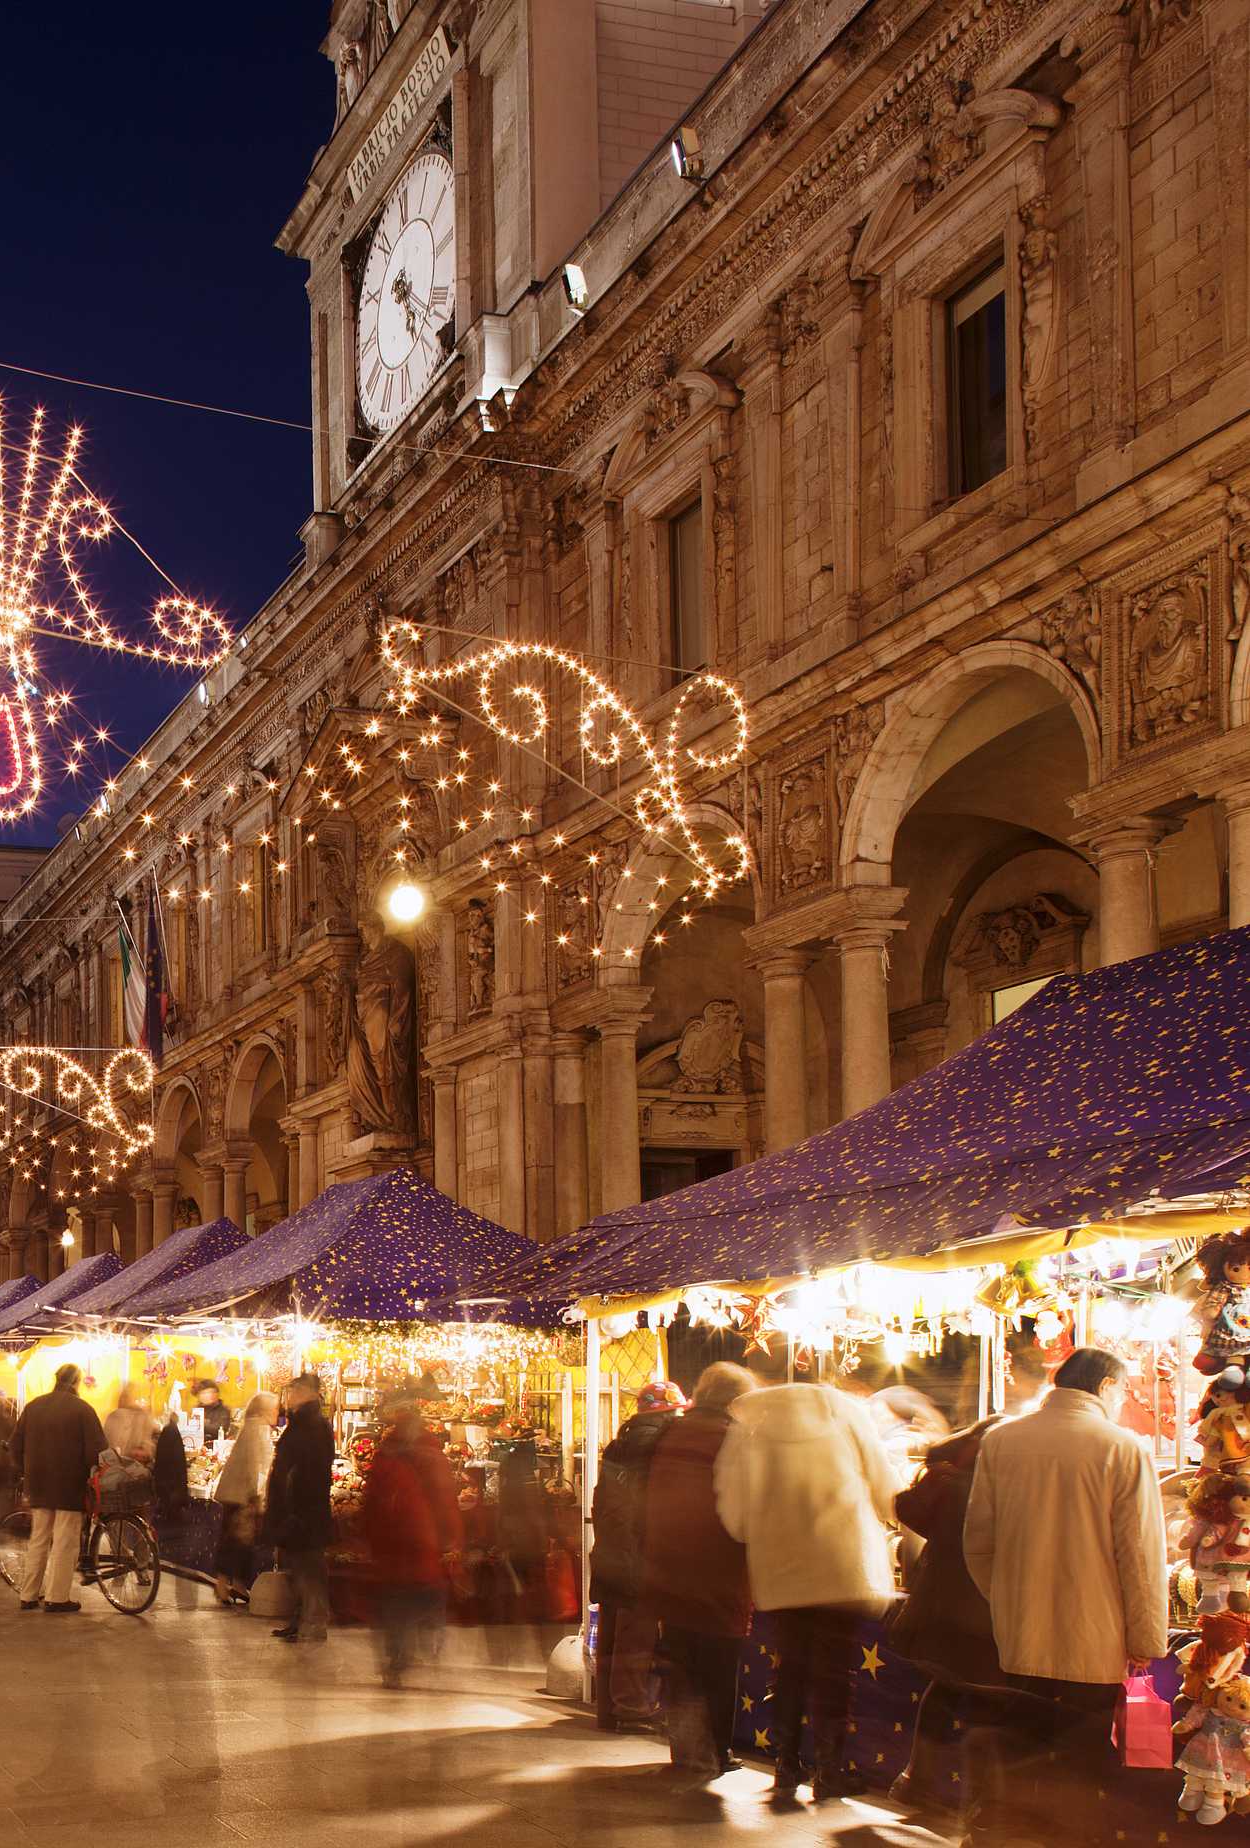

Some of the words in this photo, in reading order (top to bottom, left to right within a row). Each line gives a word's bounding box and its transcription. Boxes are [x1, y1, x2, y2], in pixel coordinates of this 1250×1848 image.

[350, 102, 398, 181] FABRICIO
[400, 36, 440, 103] BOSSIO
[354, 150, 386, 194] VRBIS
